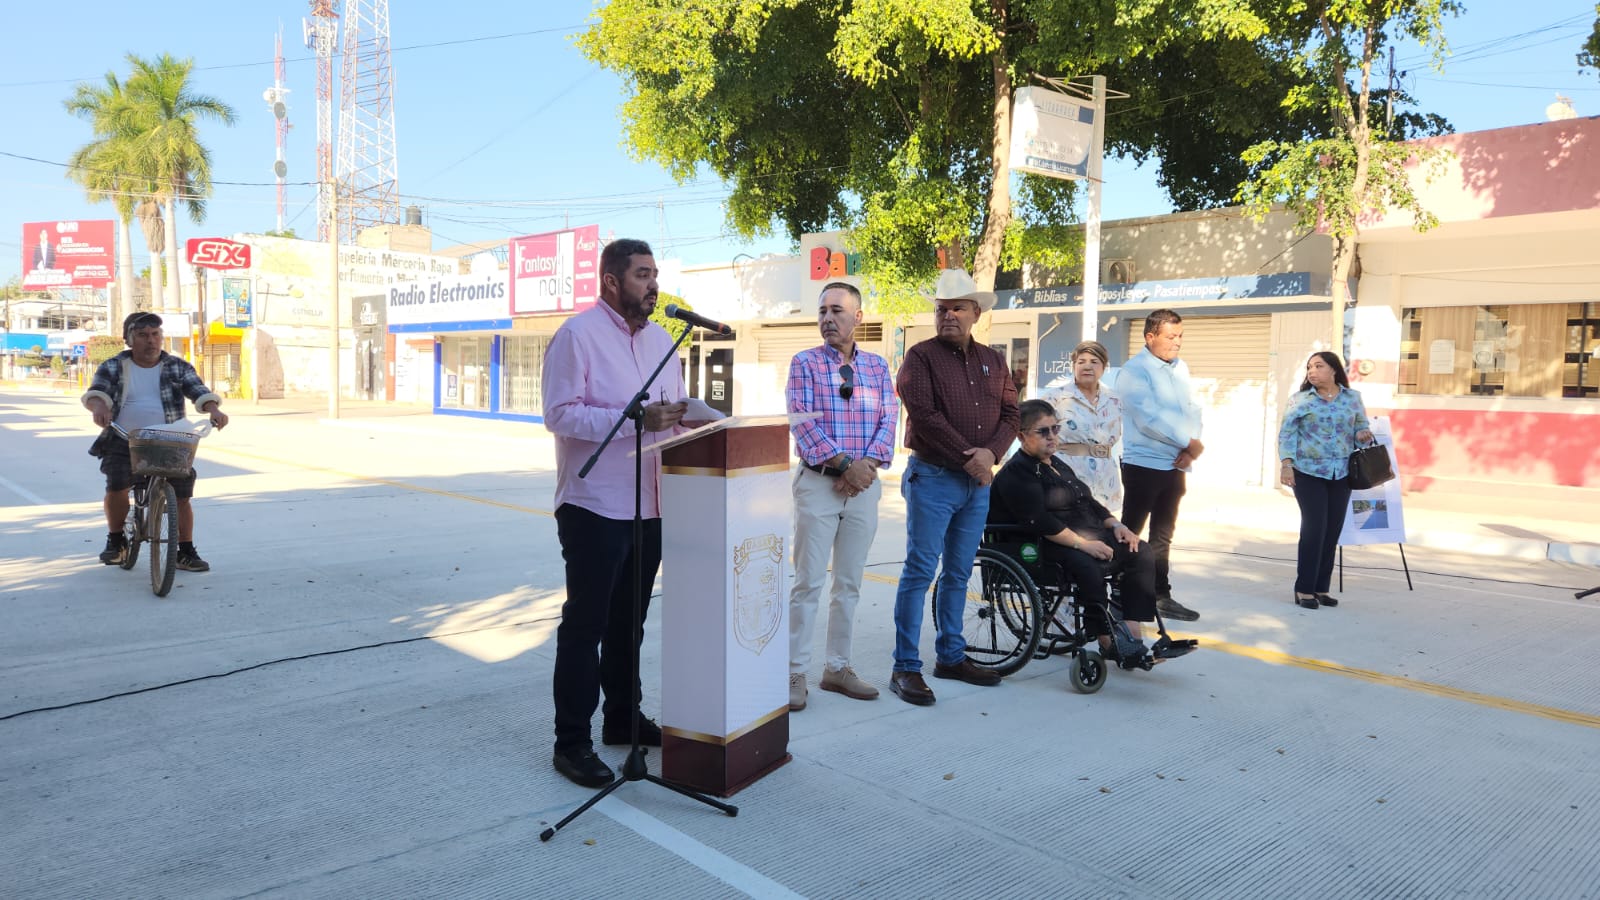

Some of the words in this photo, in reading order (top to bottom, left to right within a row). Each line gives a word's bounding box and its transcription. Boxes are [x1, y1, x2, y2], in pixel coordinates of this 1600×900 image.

[517, 245, 558, 275] Fantasy
[390, 283, 426, 307] Radio
[429, 276, 505, 304] Electronics
[539, 256, 573, 297] nails
[1034, 290, 1067, 303] Biblias
[1153, 283, 1222, 300] Pasatiempos
